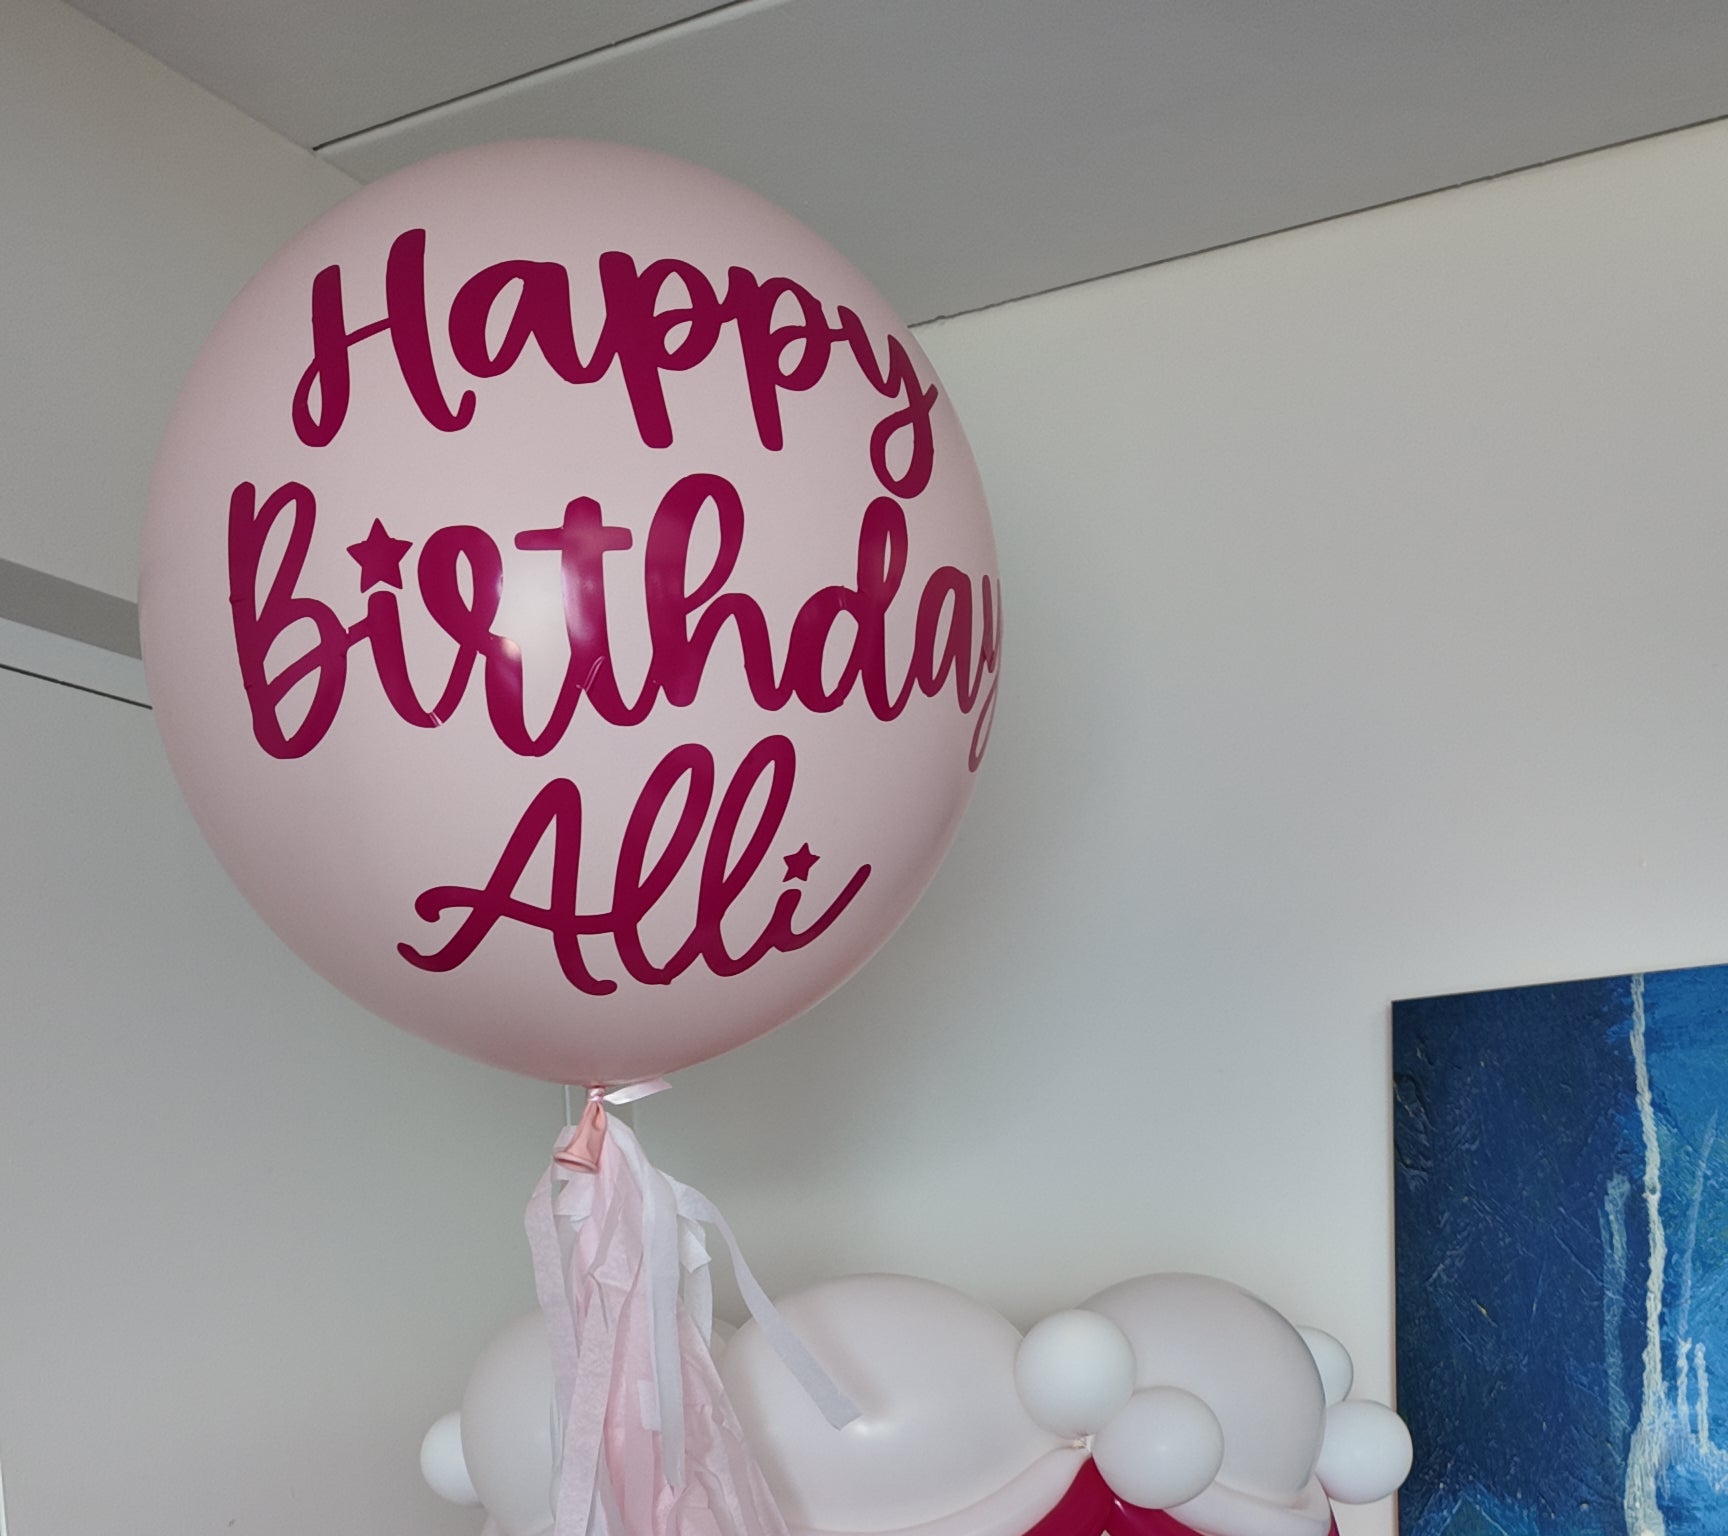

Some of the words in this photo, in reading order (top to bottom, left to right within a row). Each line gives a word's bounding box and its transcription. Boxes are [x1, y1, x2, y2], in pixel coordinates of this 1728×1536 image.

[292, 229, 938, 499] Happy
[228, 474, 1002, 773] Birthday
[397, 735, 871, 995] Alli
